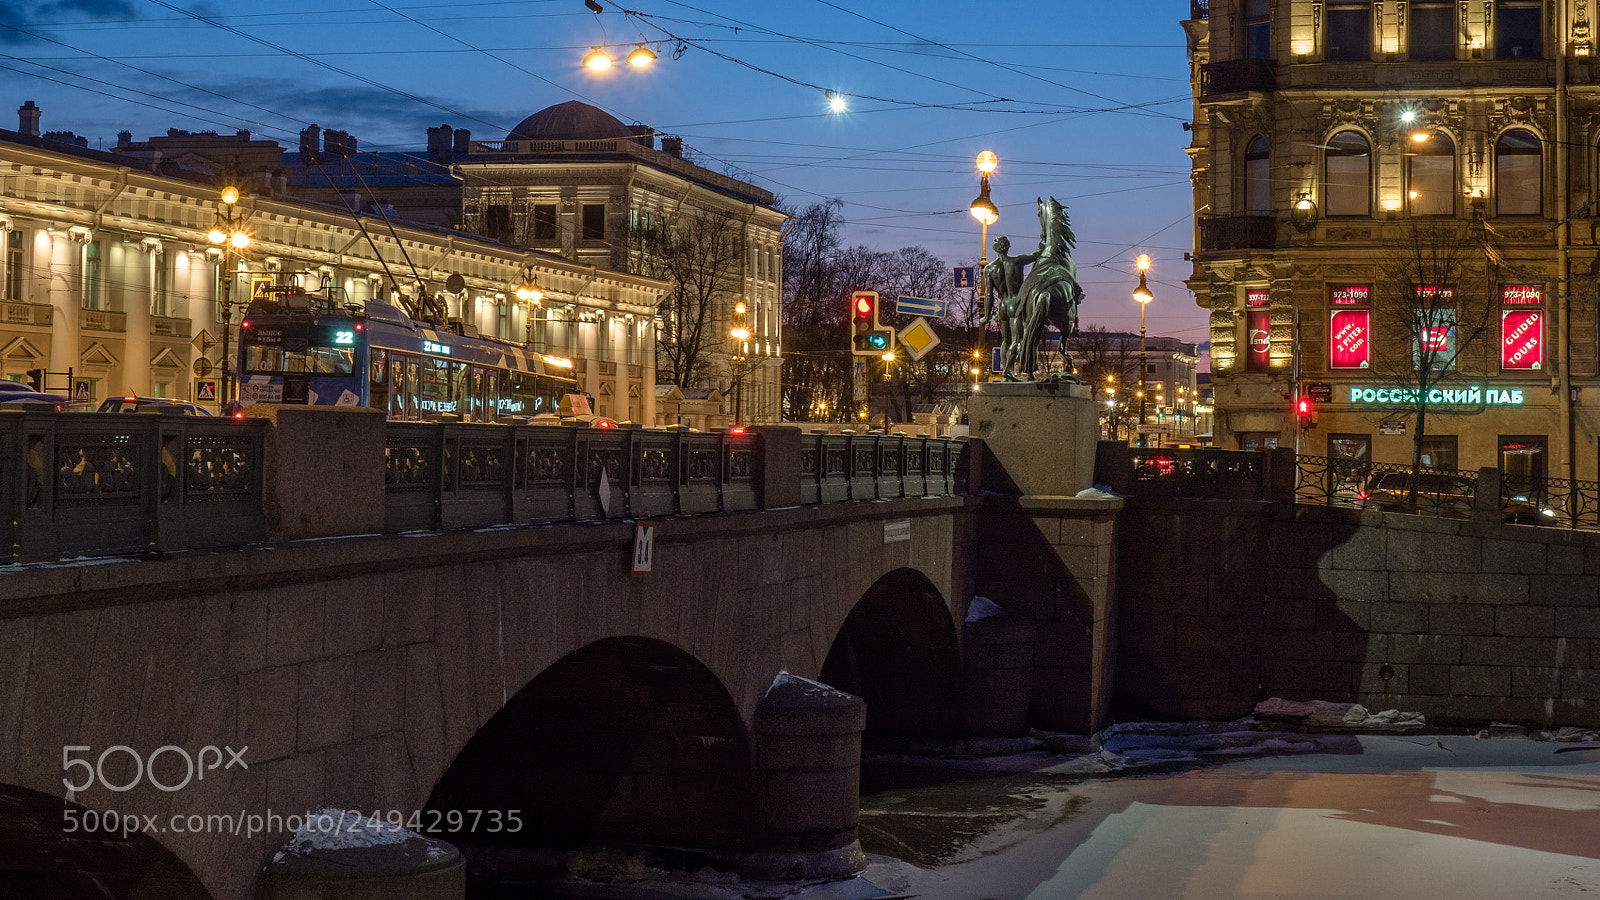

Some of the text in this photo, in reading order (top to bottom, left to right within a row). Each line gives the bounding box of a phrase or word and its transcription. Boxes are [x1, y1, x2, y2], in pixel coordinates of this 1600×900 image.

[1334, 322, 1355, 340] www.
[1505, 313, 1539, 345] GUIDED
[335, 331, 354, 344] 22
[1349, 338, 1365, 353] com
[1508, 337, 1538, 364] TOURS
[1486, 389, 1524, 404] ПАБ
